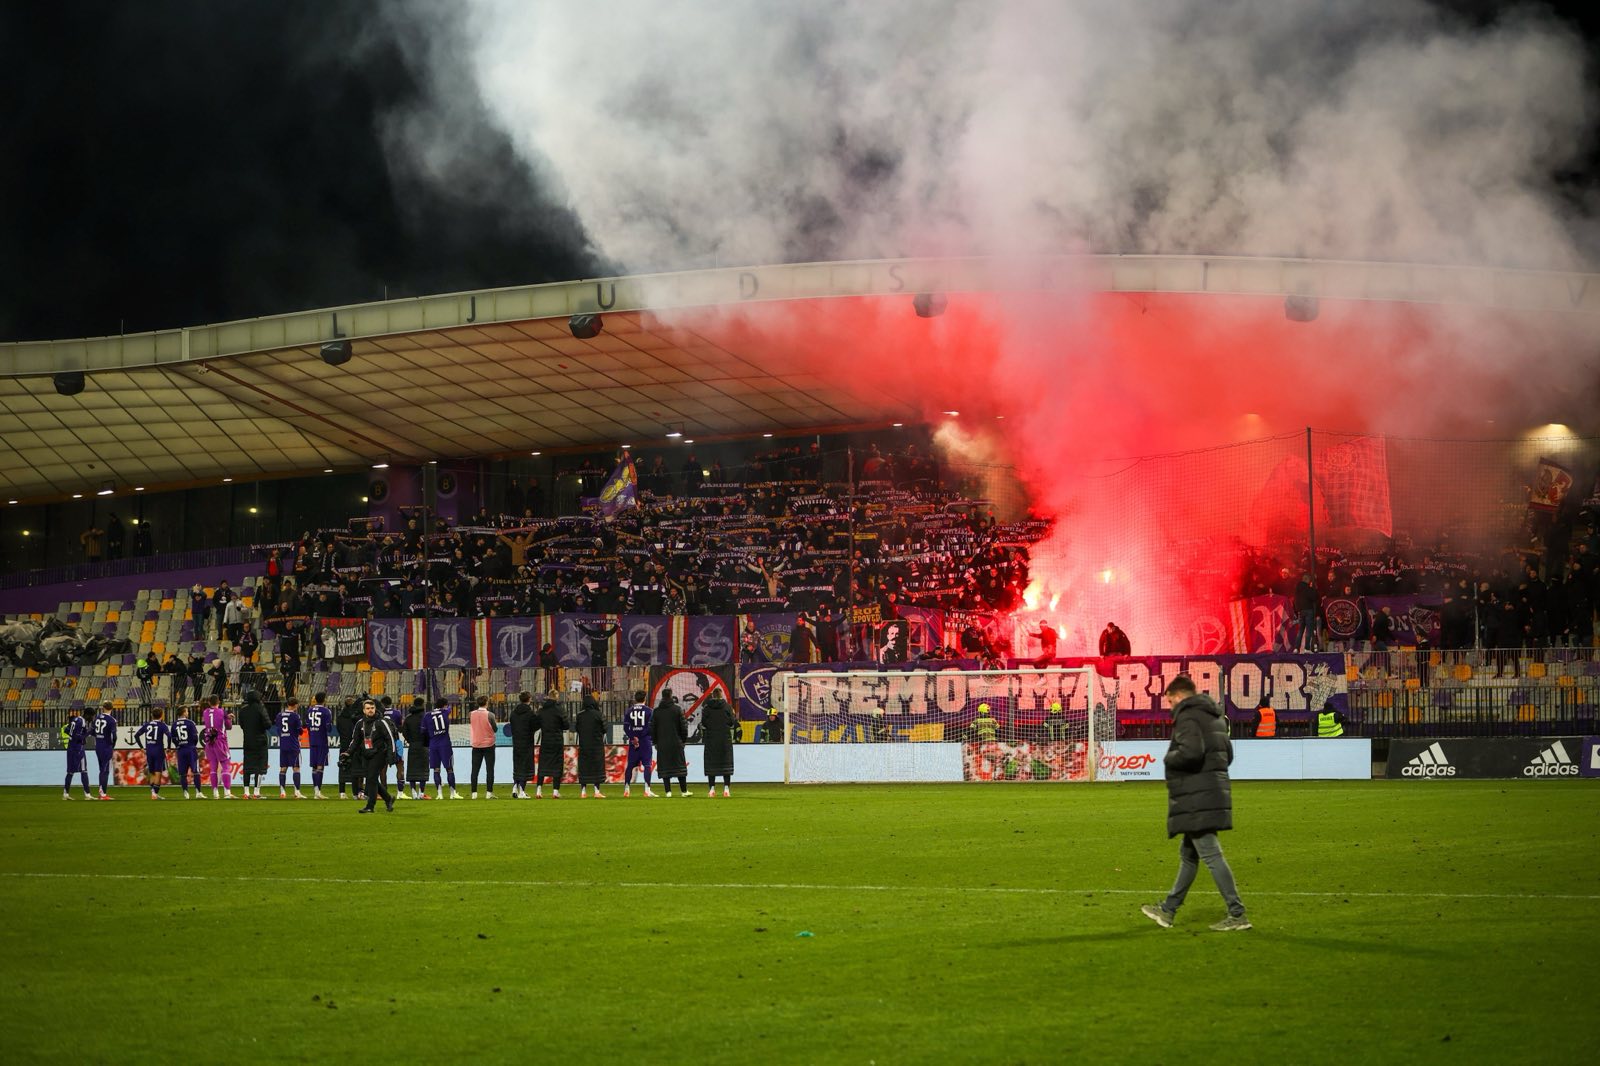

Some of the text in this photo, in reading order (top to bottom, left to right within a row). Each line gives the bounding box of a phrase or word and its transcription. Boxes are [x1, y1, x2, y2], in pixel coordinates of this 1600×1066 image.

[369, 619, 733, 668] ULTRAS
[772, 662, 1306, 714] GREMO MARIBOR
[208, 712, 214, 727] 1
[282, 717, 288, 732] 5
[308, 712, 322, 727] 45
[432, 714, 446, 730] 11
[630, 710, 646, 726] 44
[95, 719, 107, 734] 97
[146, 726, 158, 740] 21
[176, 726, 188, 740] 15
[1402, 763, 1456, 777] adidas
[1524, 762, 1579, 776] adidas
